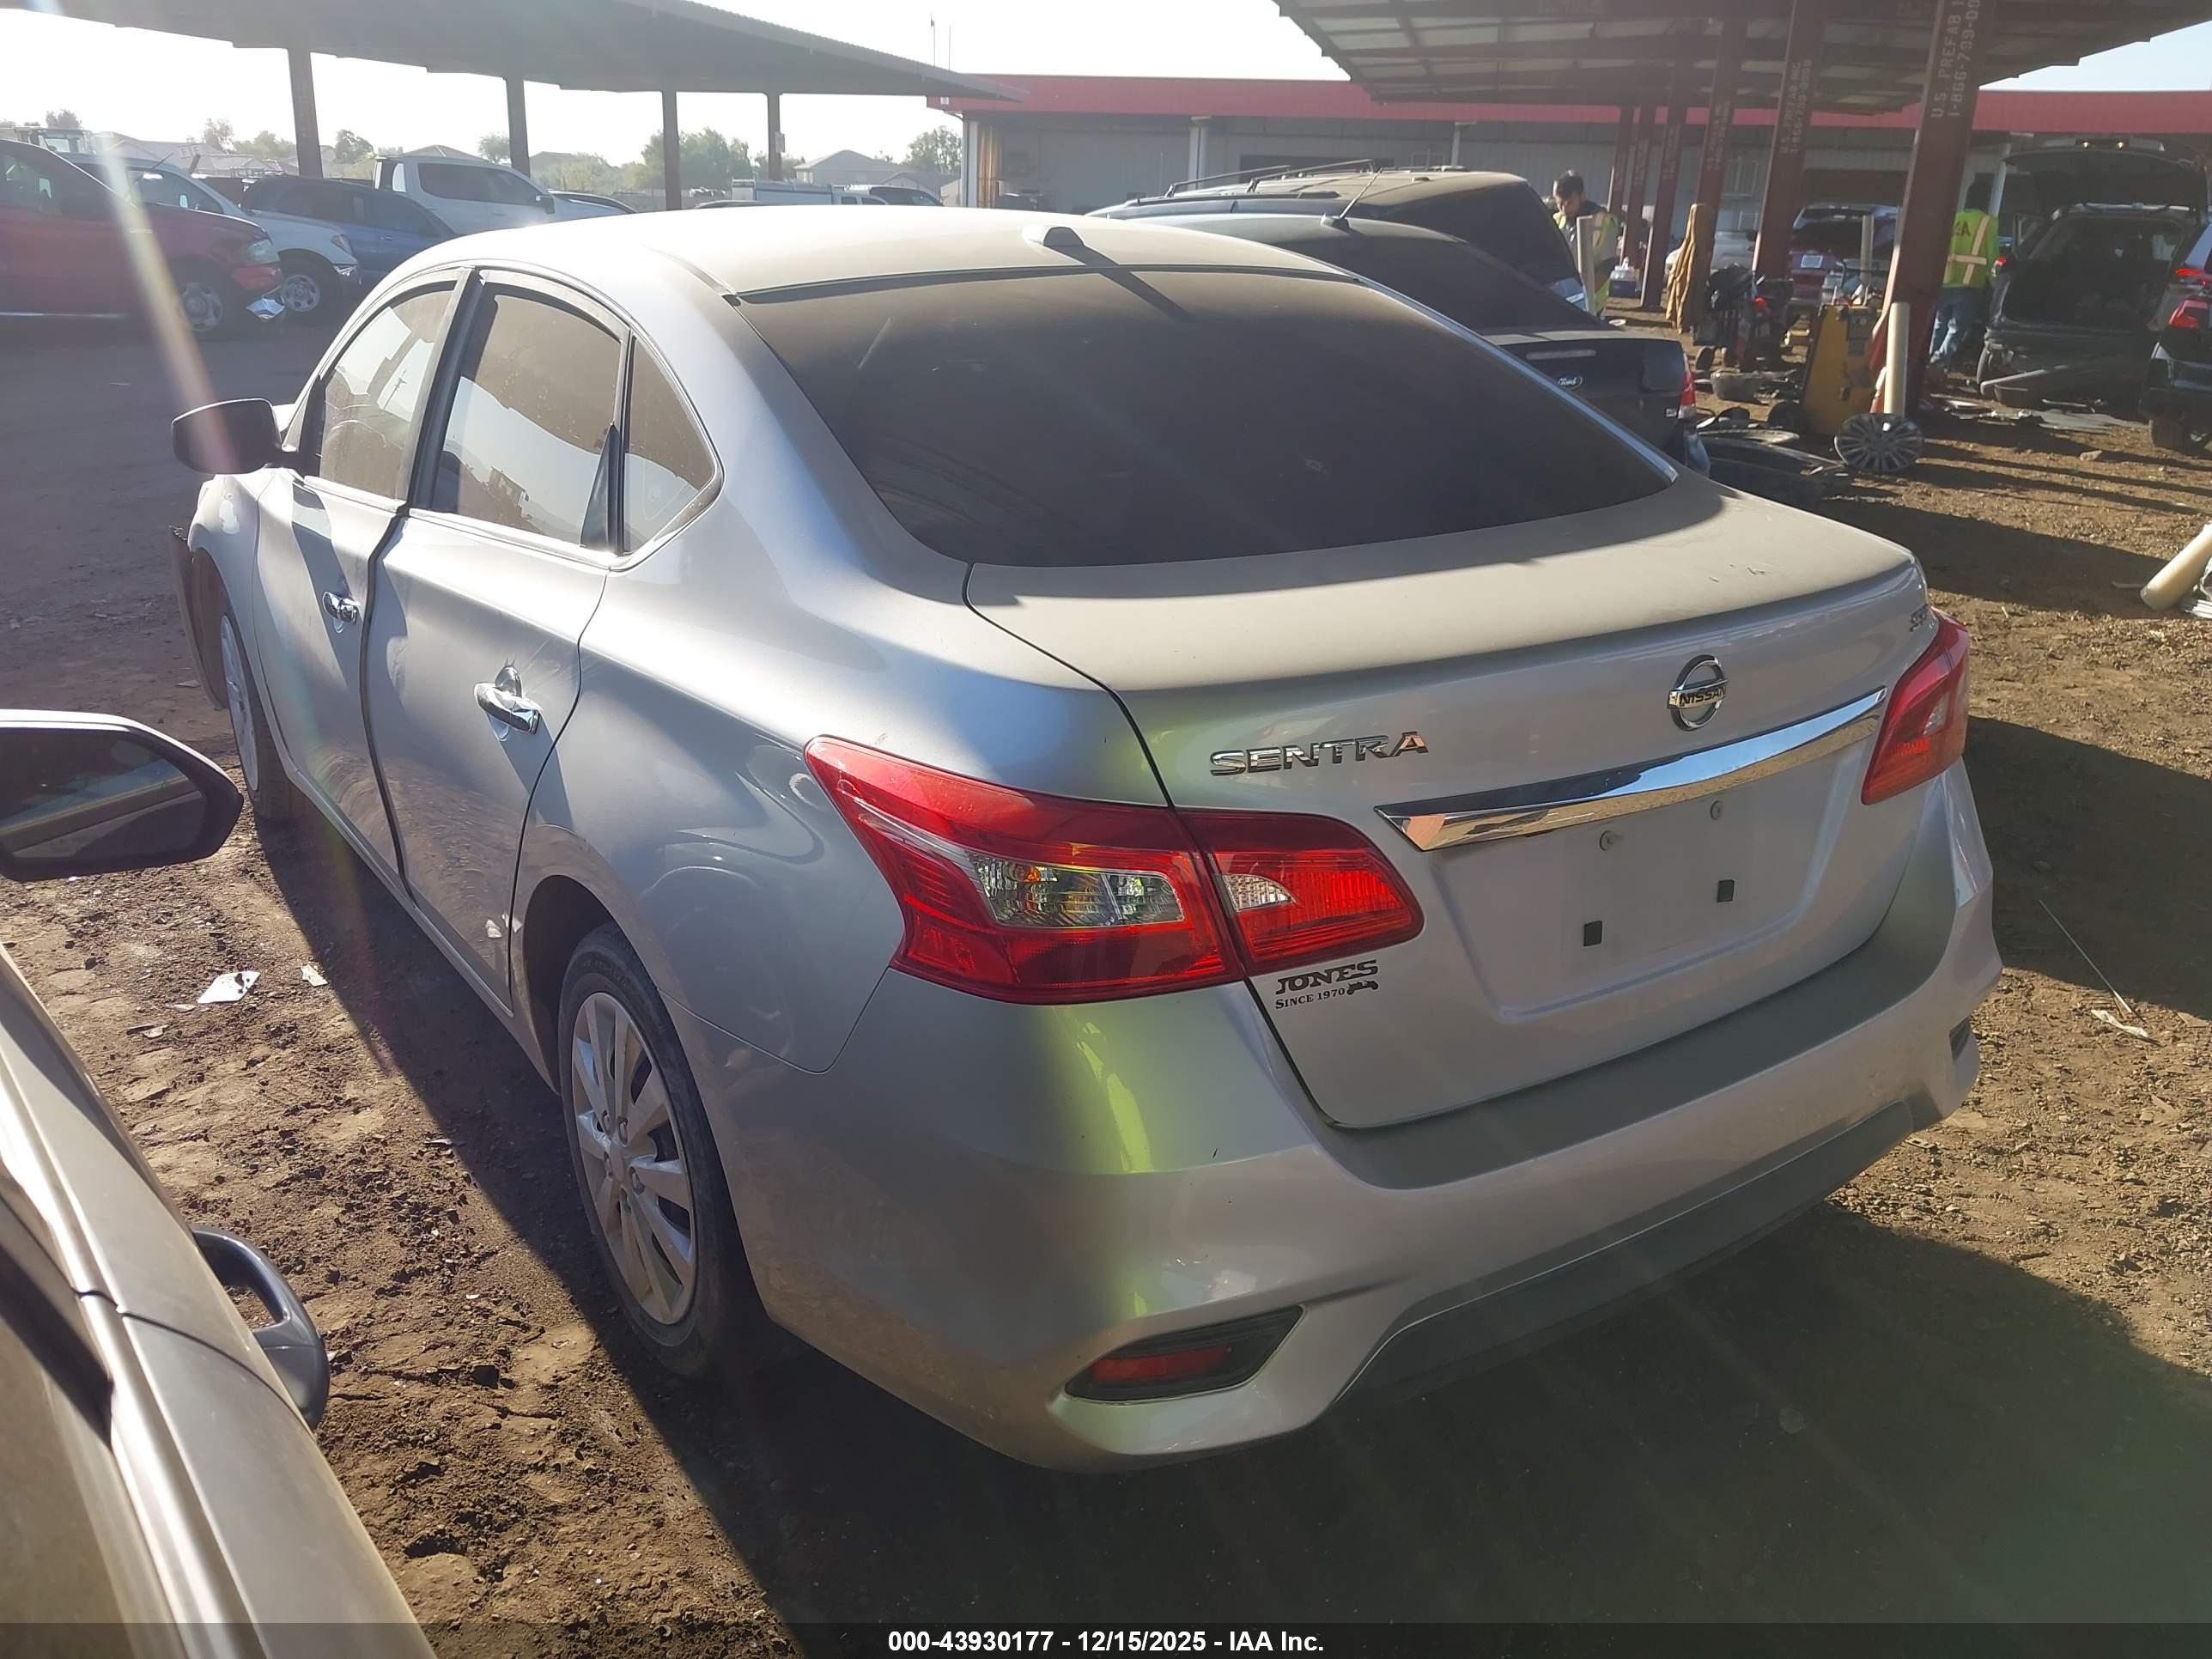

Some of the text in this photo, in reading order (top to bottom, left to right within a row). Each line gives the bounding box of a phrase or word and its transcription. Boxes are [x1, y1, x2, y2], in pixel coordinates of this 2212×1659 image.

[1937, 14, 1961, 78] PREFAB
[1679, 686, 1726, 707] NISSAN
[1209, 731, 1429, 776] SENTRA
[1275, 959, 1378, 994] JONES
[1318, 988, 1346, 1000] 1970
